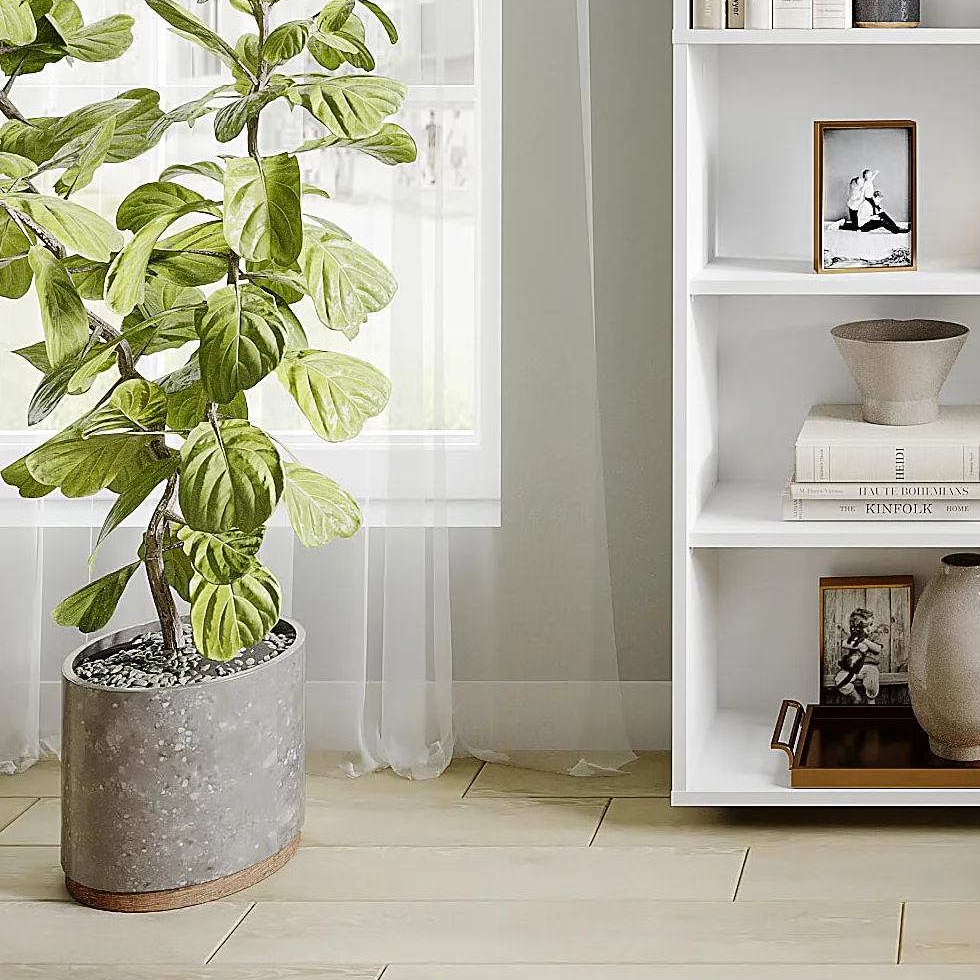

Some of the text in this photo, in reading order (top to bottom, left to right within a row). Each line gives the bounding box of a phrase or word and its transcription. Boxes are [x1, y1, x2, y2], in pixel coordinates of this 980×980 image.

[895, 447, 905, 480] HEIDI
[858, 486, 897, 496] HAUTE
[901, 486, 969, 496] BOHEMIANS
[865, 503, 933, 514] KINFOLK
